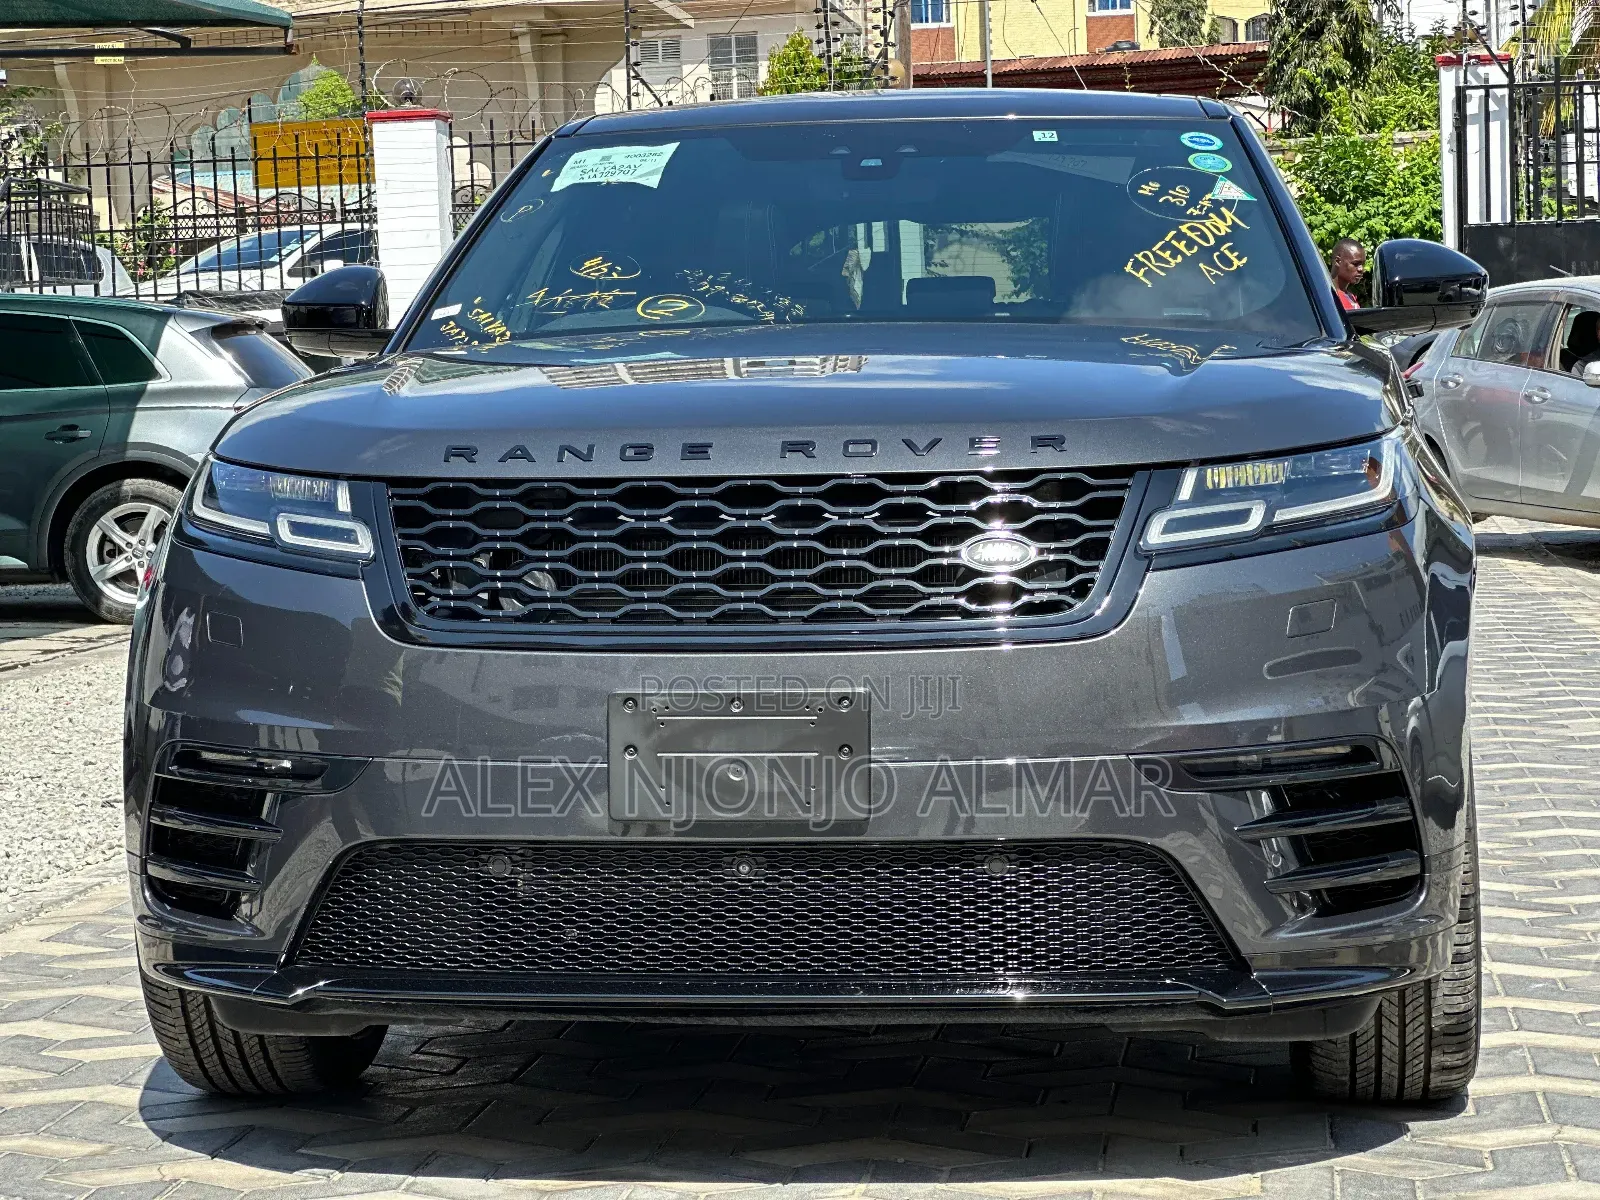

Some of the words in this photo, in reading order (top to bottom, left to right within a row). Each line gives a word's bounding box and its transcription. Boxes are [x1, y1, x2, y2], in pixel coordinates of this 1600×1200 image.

[1199, 243, 1247, 284] ACE
[443, 442, 714, 463] RANGE
[780, 434, 1067, 458] ROVER
